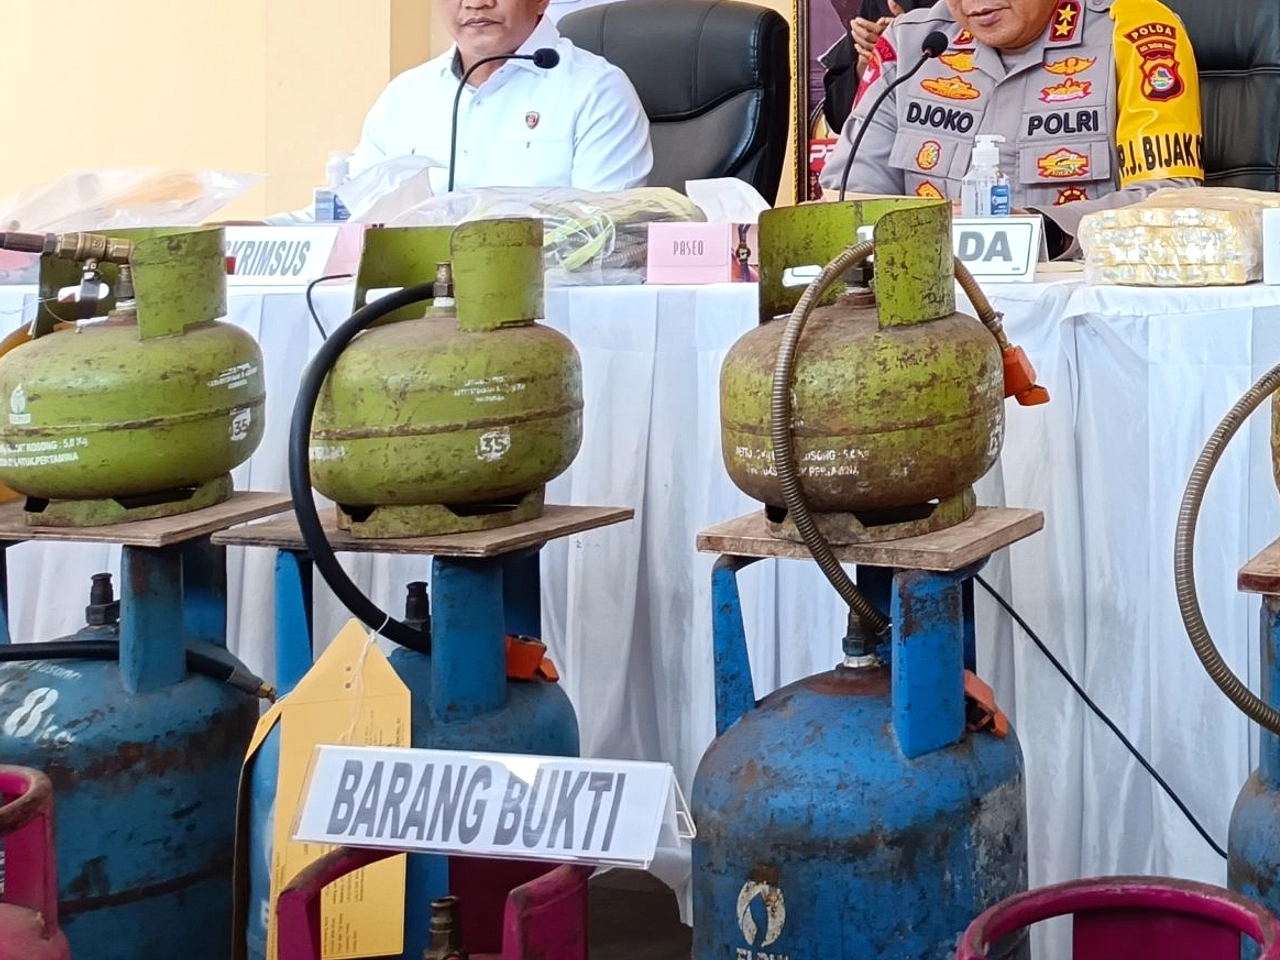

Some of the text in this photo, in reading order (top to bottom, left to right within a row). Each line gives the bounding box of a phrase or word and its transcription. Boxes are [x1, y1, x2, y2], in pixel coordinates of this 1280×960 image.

[1131, 24, 1172, 40] POLDA
[906, 101, 974, 133] DJOKO
[1027, 110, 1099, 136] POLRI
[1142, 132, 1196, 171] BIJAK
[673, 240, 704, 256] PASEO
[232, 419, 250, 436] 35
[478, 436, 508, 455] 35
[326, 759, 626, 852] BARANG BUKTI
